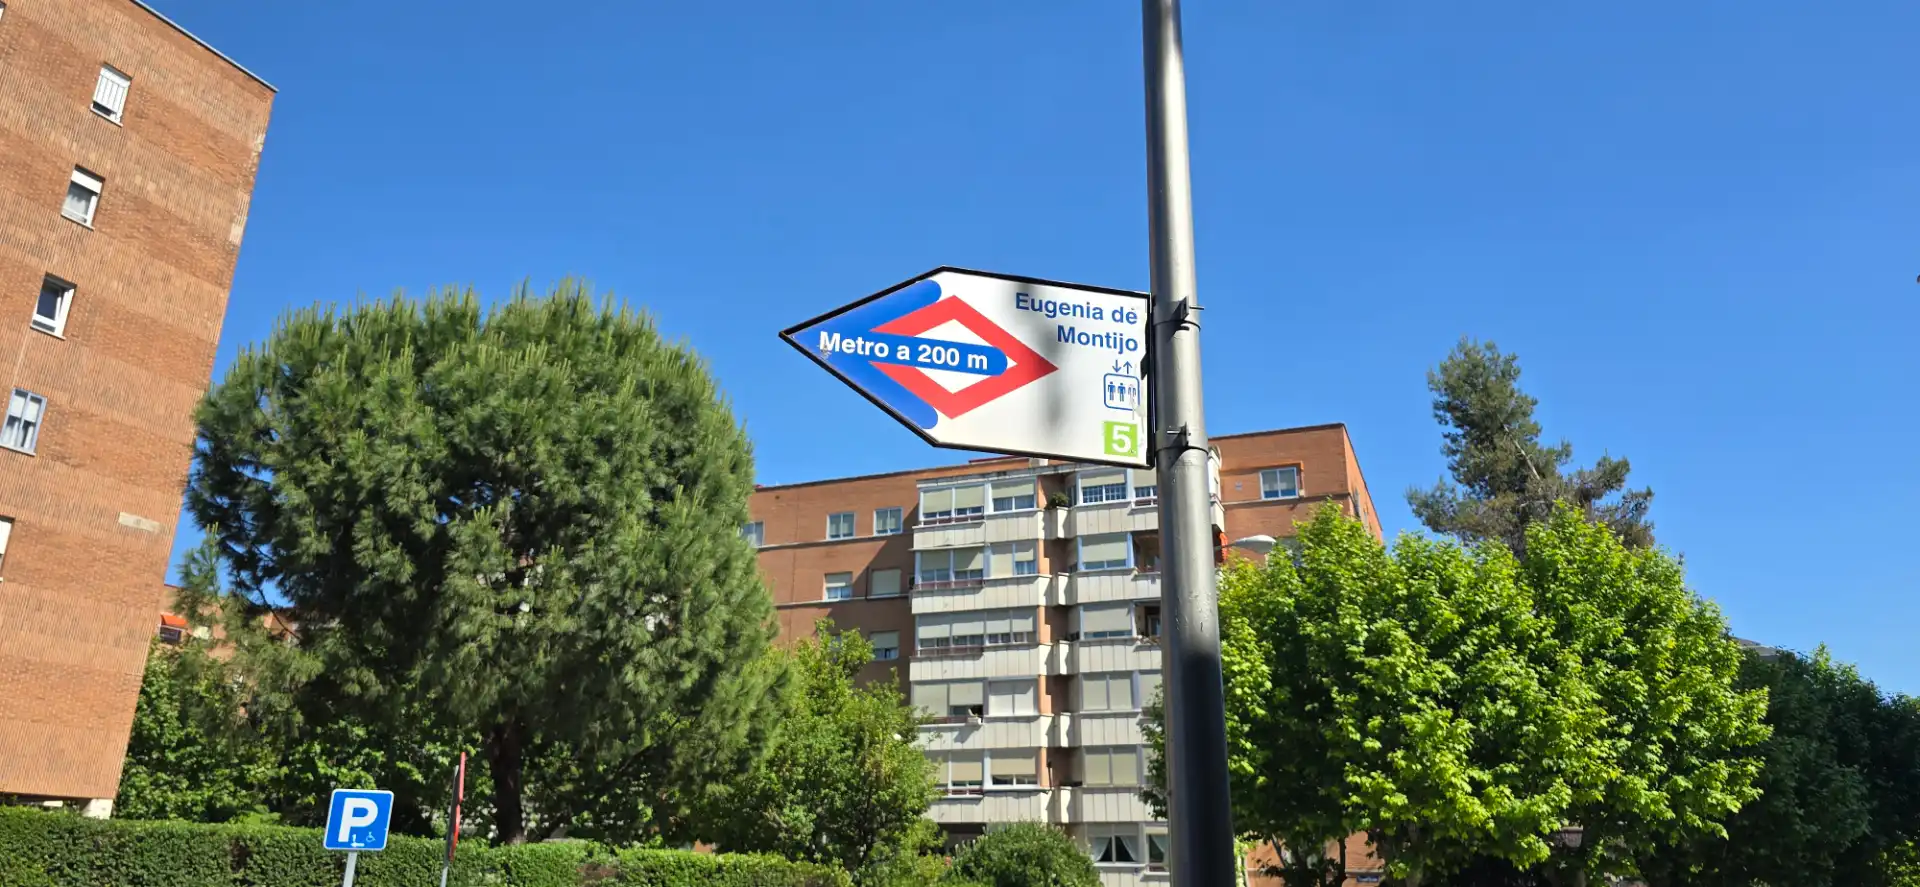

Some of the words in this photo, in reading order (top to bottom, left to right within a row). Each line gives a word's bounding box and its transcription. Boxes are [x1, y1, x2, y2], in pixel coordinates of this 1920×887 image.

[1015, 292, 1104, 319] Eugenia
[1111, 306, 1138, 325] de
[819, 330, 889, 358] Metro
[896, 344, 910, 361] a
[917, 344, 960, 367] 200
[967, 353, 988, 370] m
[1057, 324, 1138, 355] Montijo
[1112, 425, 1132, 453] 5
[337, 797, 379, 843] P
